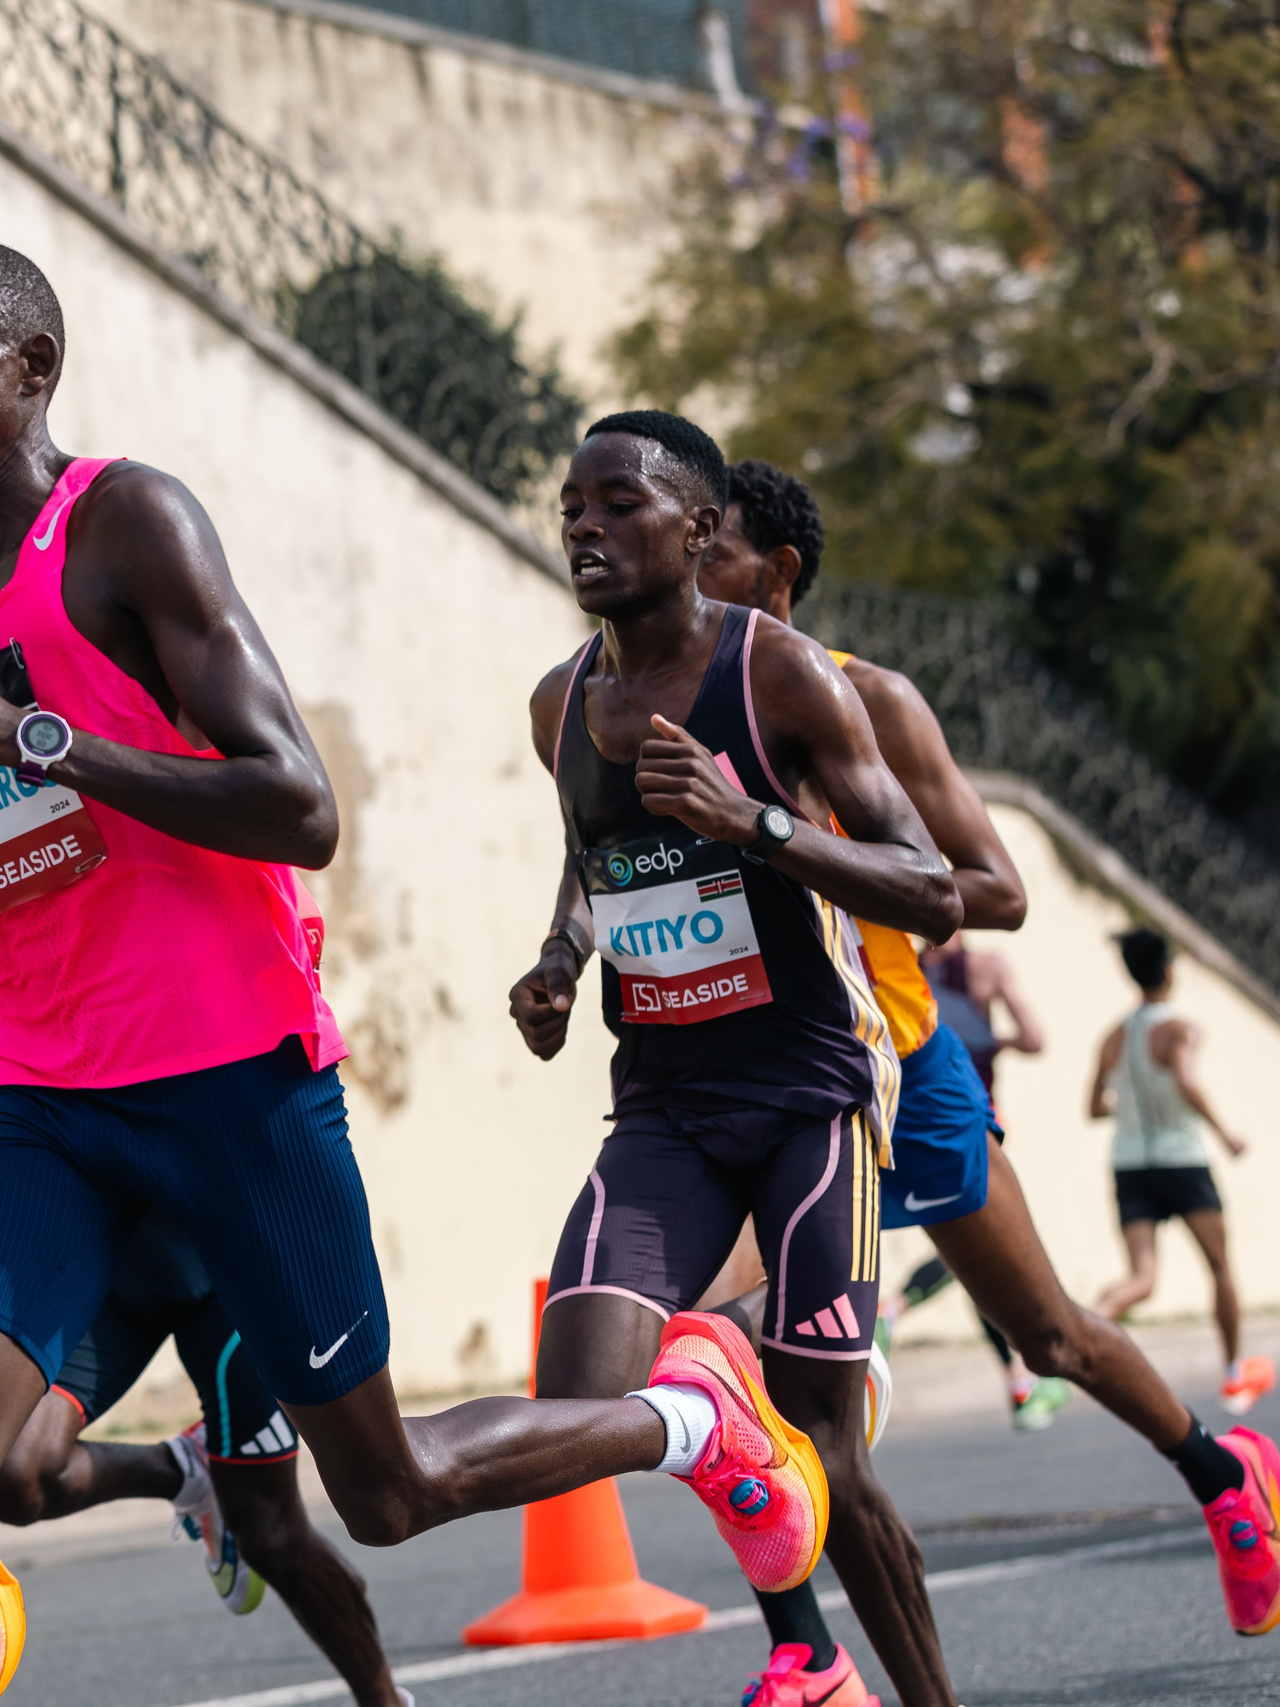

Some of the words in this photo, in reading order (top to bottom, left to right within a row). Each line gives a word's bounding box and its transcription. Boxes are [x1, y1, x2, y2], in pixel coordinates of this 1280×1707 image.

[50, 799, 70, 814] 2024
[635, 843, 684, 875] edp
[610, 910, 724, 957] KITIYO
[729, 946, 749, 956] 2024
[662, 973, 749, 1009] SEASIDE
